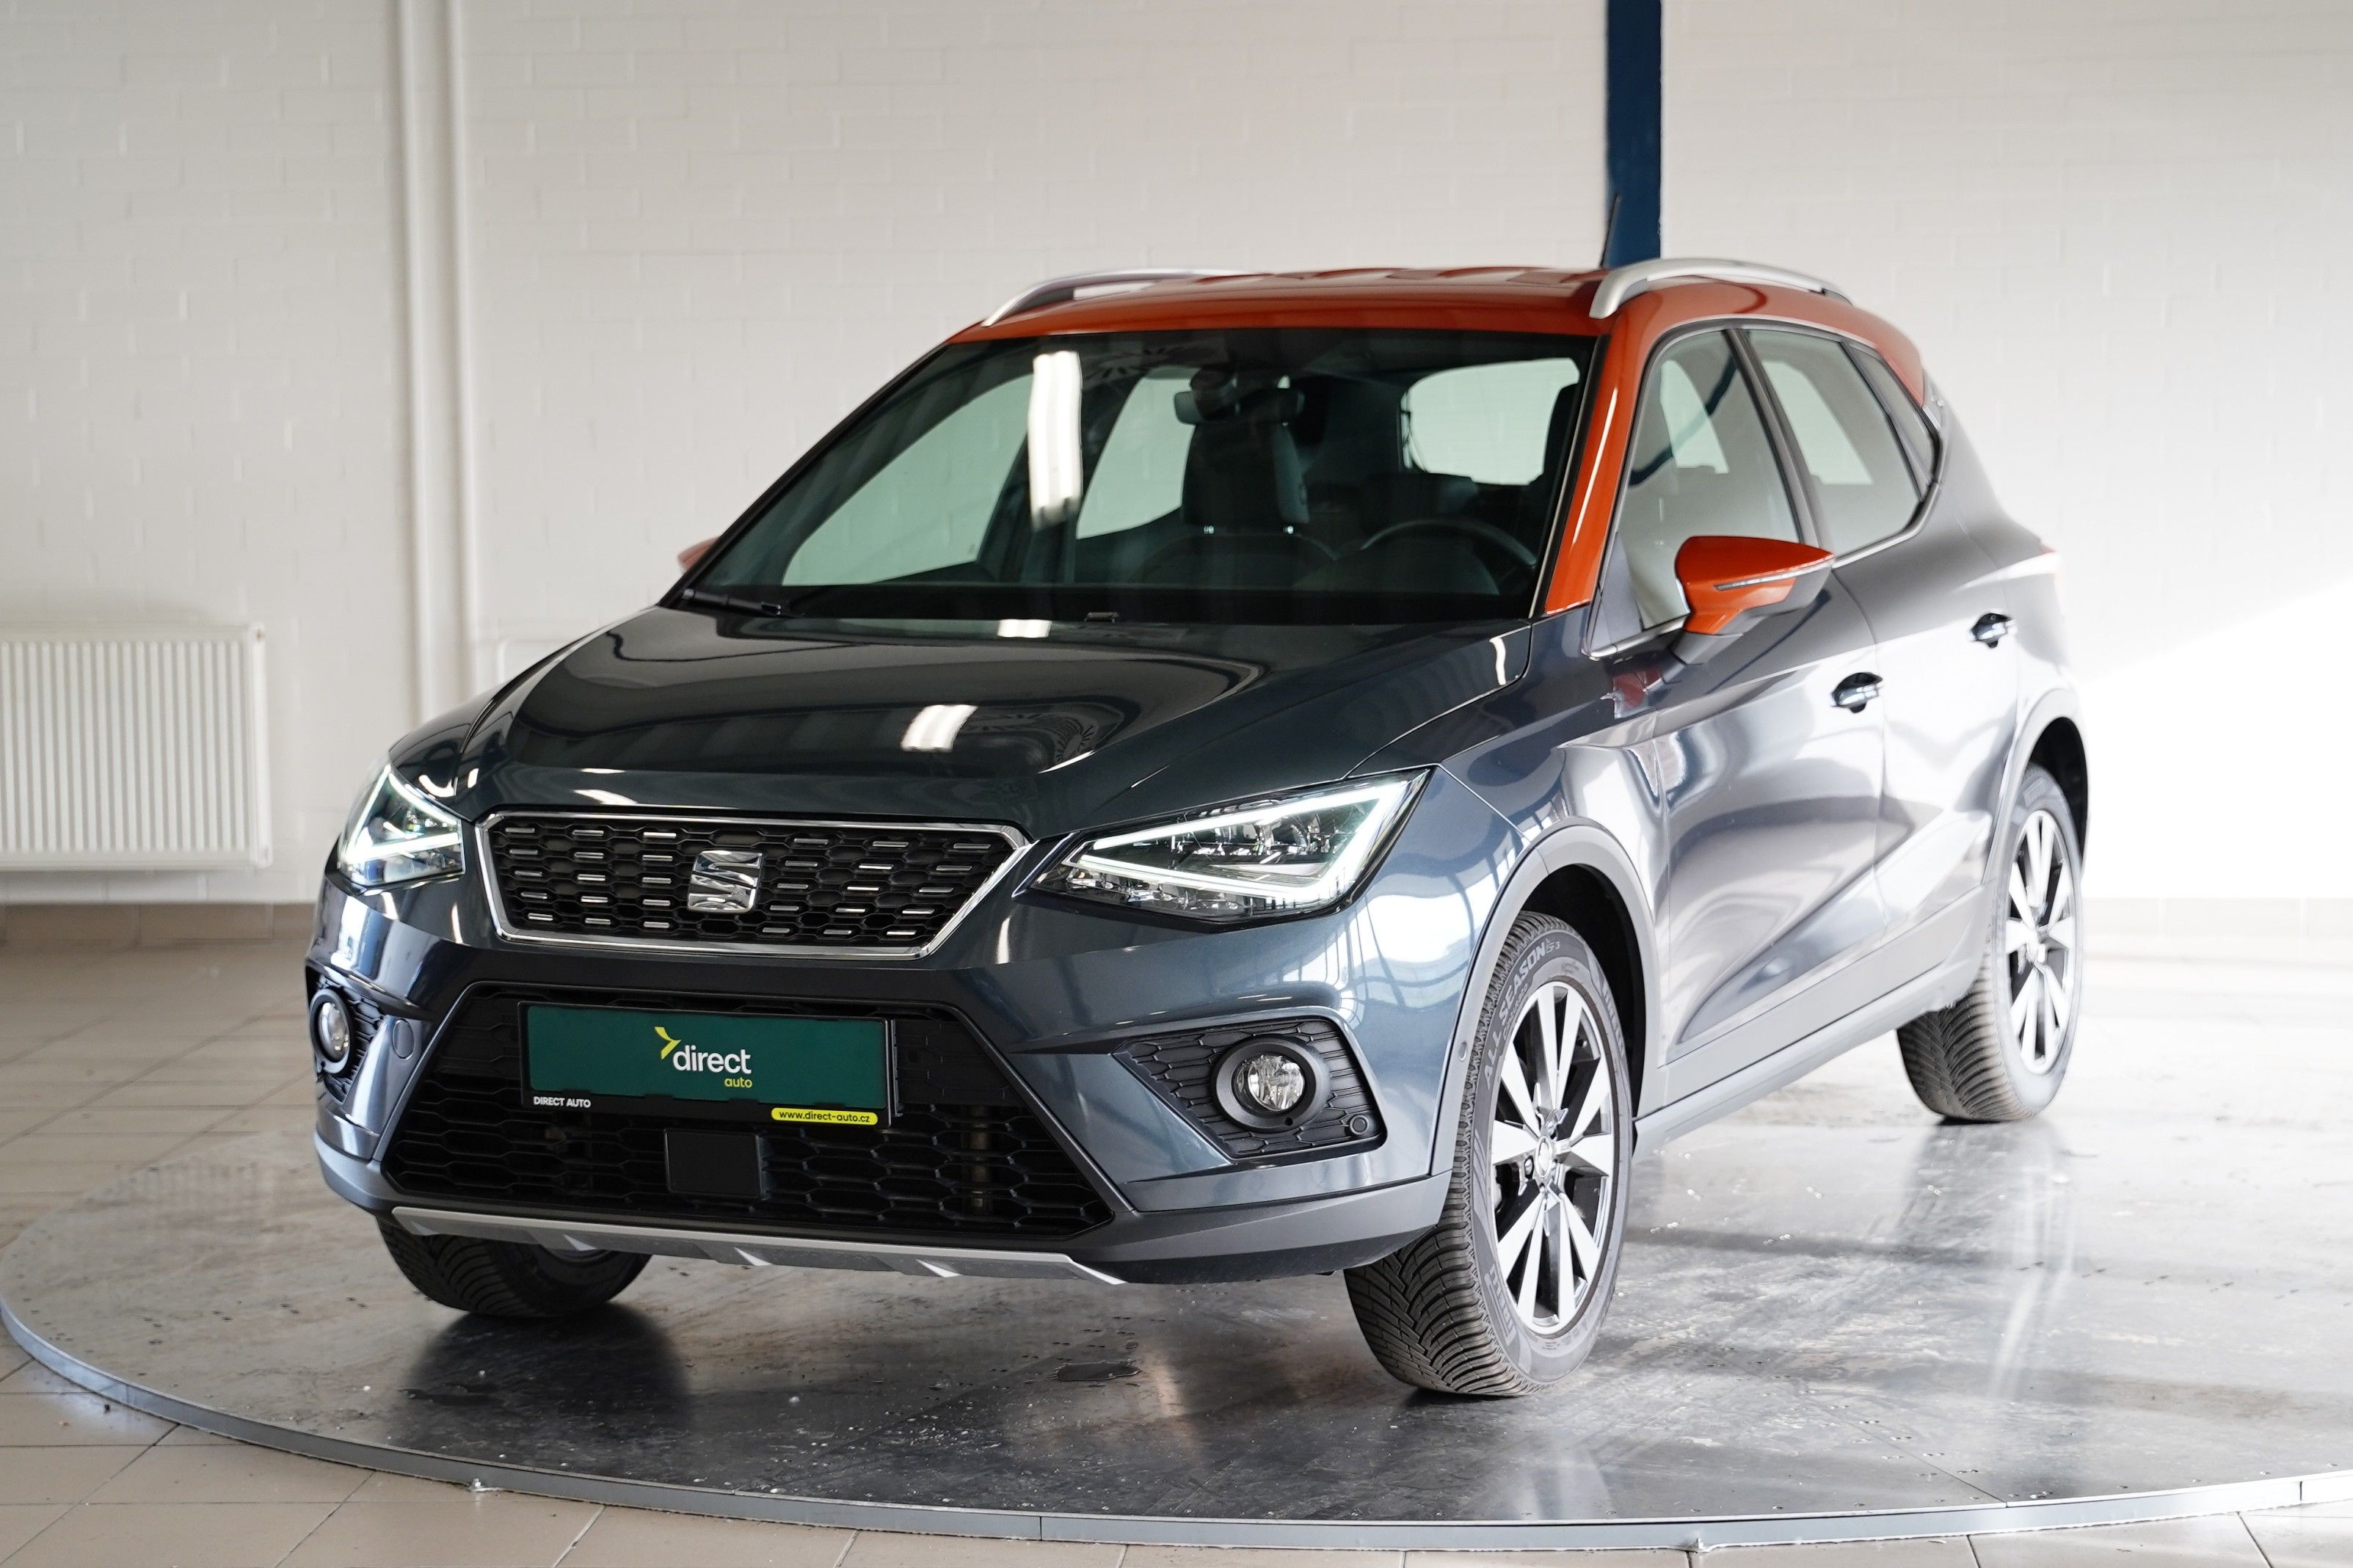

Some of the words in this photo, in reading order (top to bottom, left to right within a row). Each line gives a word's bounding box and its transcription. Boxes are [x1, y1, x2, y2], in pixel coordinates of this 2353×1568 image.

[1484, 1031, 1502, 1091] ALL
[1498, 941, 1546, 1026] SEASON
[673, 1045, 752, 1074] direct
[724, 1077, 753, 1088] auto
[534, 1096, 565, 1106] DIRECT
[566, 1098, 592, 1108] AUTO
[779, 1111, 870, 1123] www.direct-auto.cz
[1484, 1263, 1517, 1346] PIRELLI
